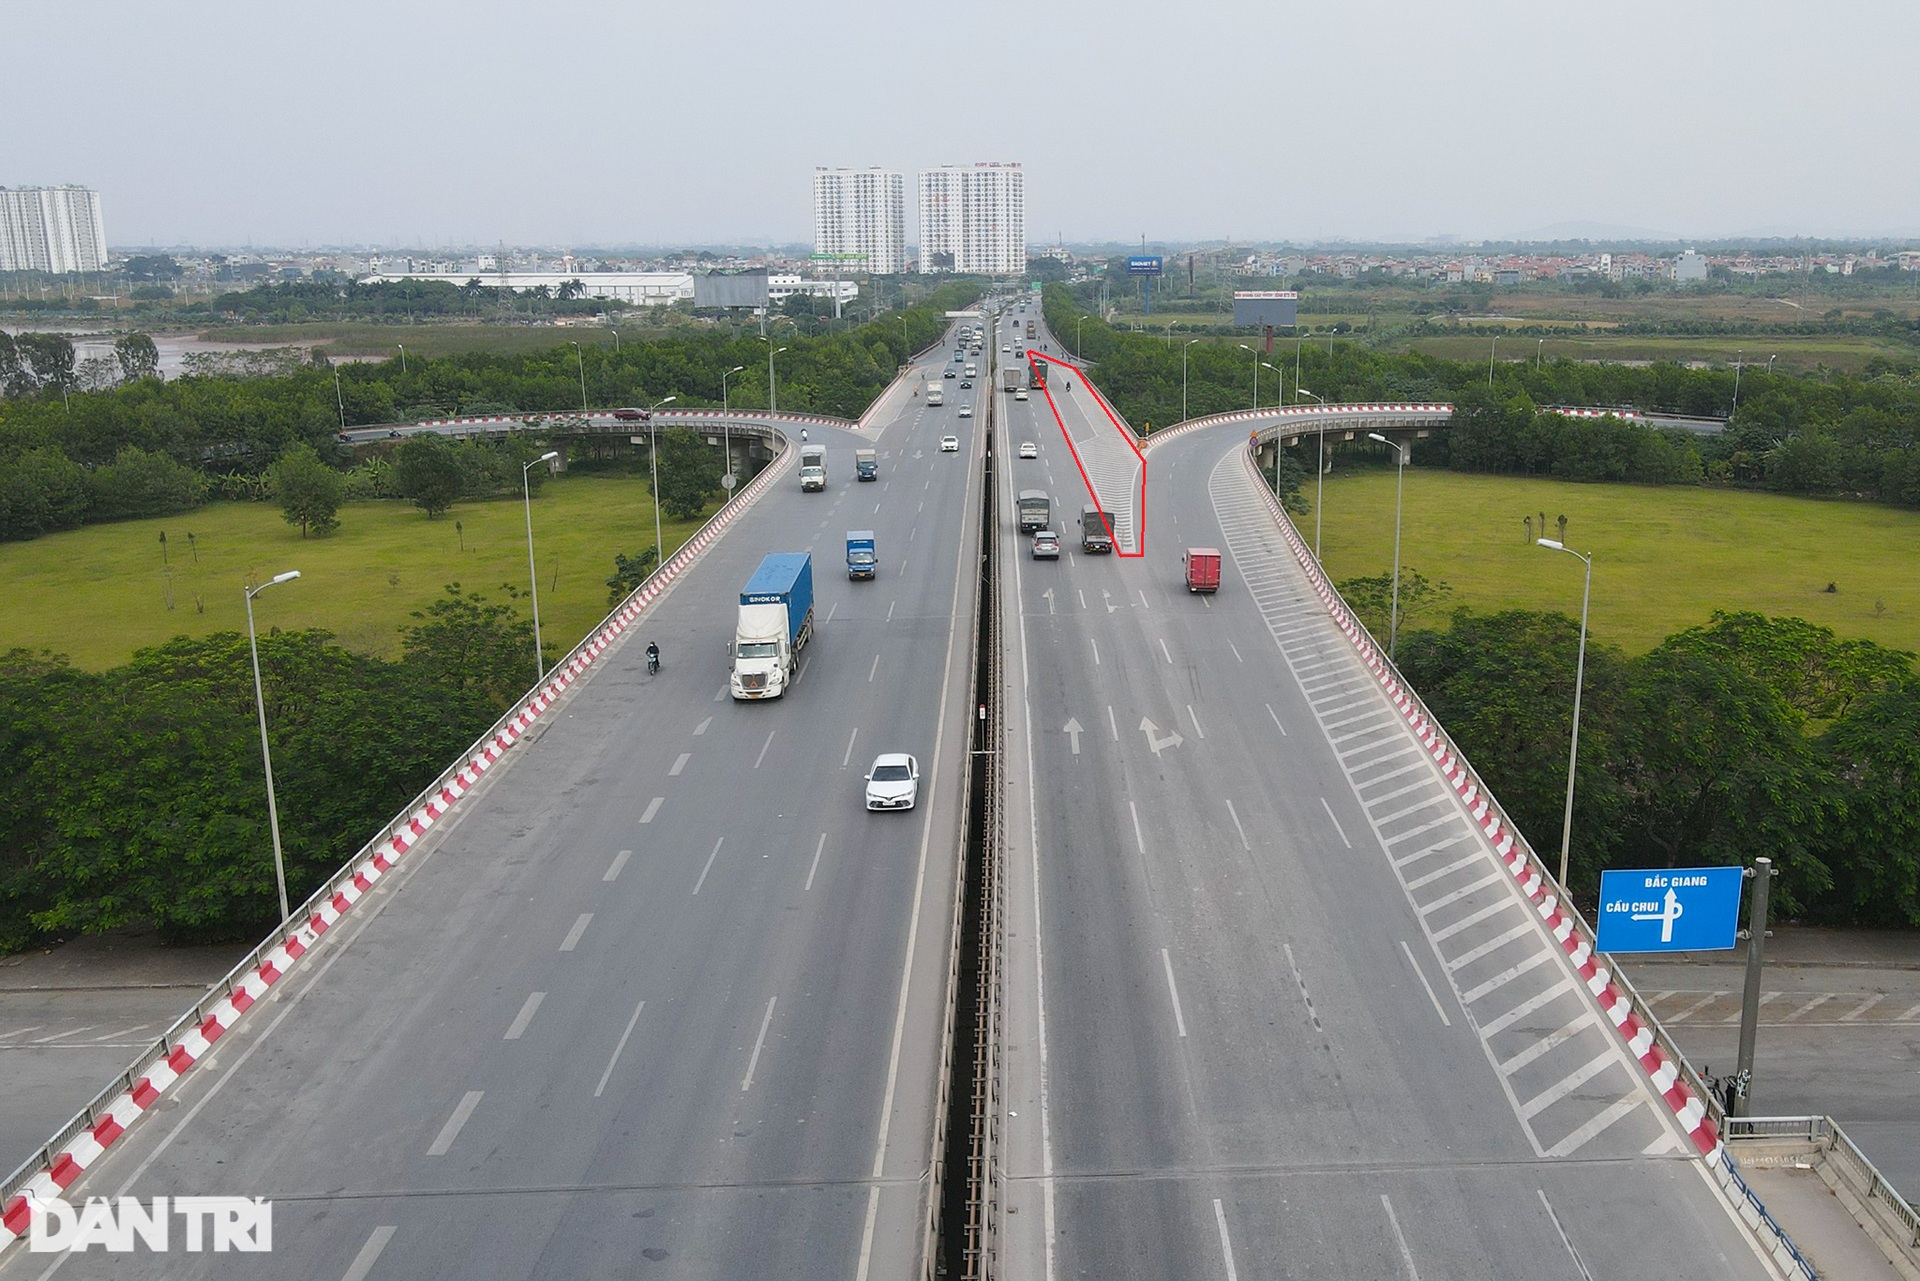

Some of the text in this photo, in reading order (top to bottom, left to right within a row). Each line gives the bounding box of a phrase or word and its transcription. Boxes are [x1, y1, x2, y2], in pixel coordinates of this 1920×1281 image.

[1644, 873, 1708, 888] BẮC GIANG
[1631, 902, 1659, 912] CHUI
